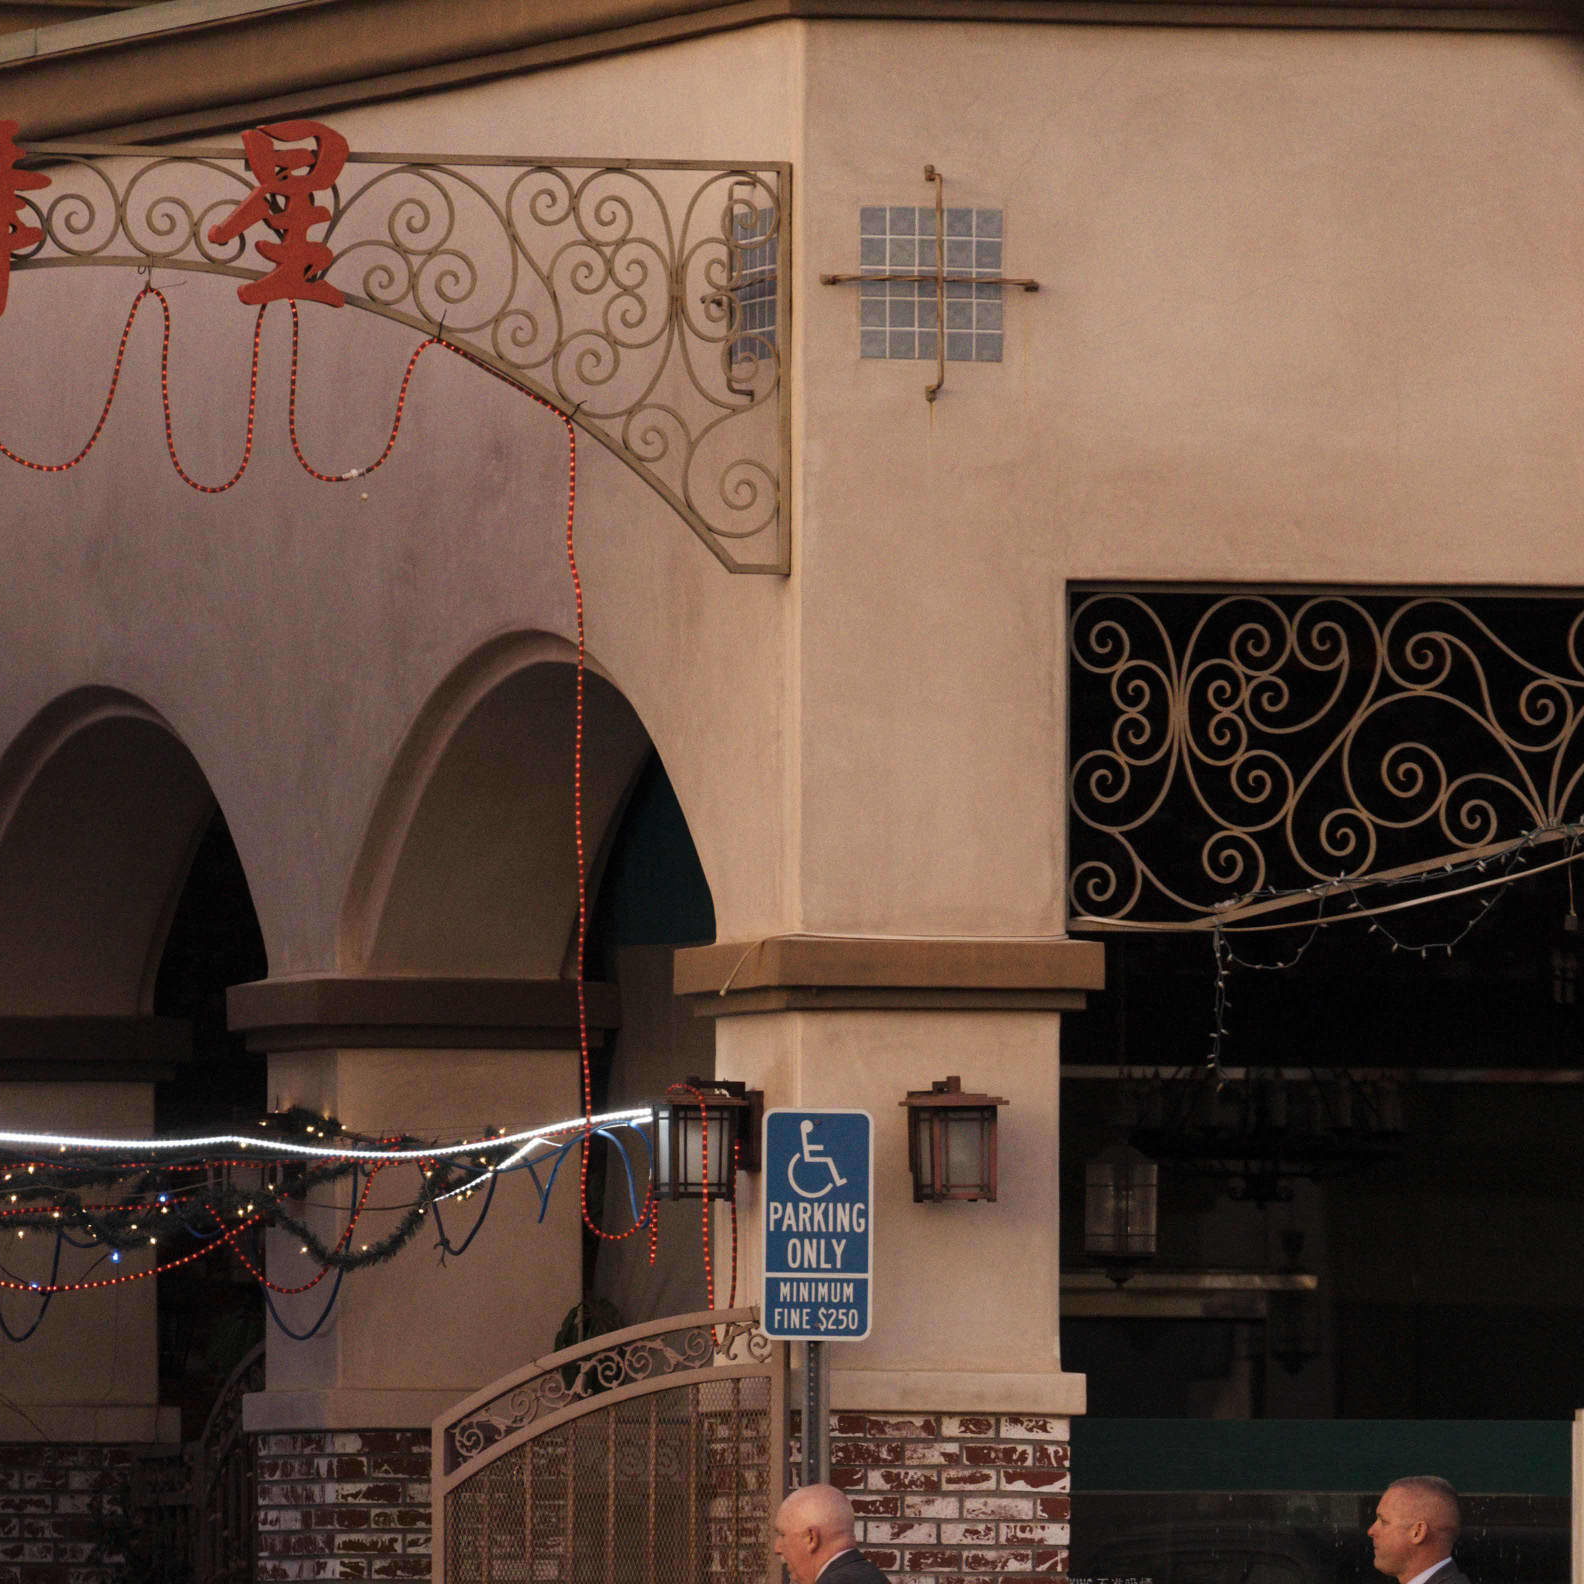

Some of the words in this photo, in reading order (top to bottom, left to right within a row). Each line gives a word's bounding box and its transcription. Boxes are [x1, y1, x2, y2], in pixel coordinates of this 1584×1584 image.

[769, 1202, 865, 1233] PARKING
[787, 1238, 847, 1269] ONLY
[779, 1281, 854, 1303] MINIMUM
[774, 1308, 812, 1329] FINE
[817, 1306, 859, 1331] $250
